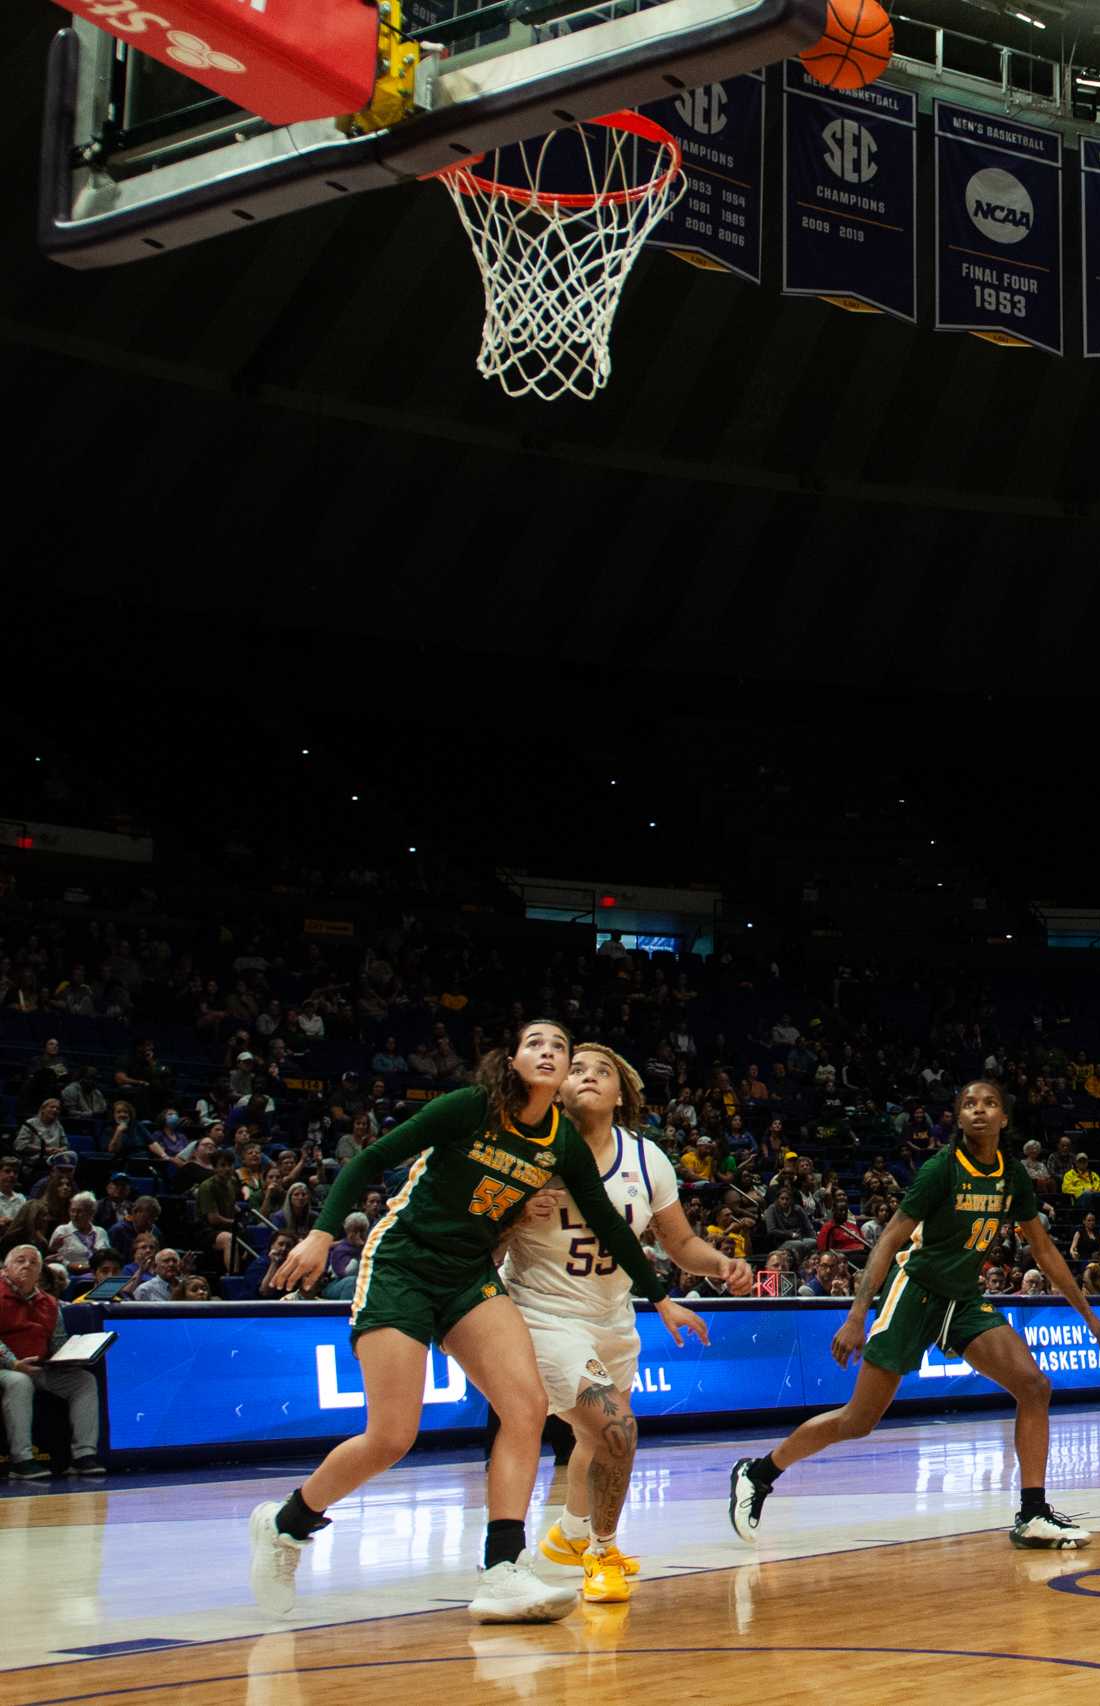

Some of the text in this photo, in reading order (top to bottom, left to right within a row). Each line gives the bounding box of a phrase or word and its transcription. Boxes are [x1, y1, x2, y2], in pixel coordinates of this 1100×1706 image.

[821, 118, 880, 184] SEC
[952, 116, 1046, 153] MEN'S BASKETBALL
[675, 136, 735, 169] HAMPIONS
[816, 184, 886, 214] CHAMPIONS
[973, 199, 1033, 231] NCAA
[801, 215, 865, 242] 2009 2019
[961, 262, 1039, 295] FINAL FOUR
[973, 284, 1027, 319] 1953
[468, 1175, 526, 1222] 55
[963, 1218, 1000, 1252] 10
[566, 1237, 618, 1278] 55
[1024, 1325, 1098, 1347] WOMEN'S
